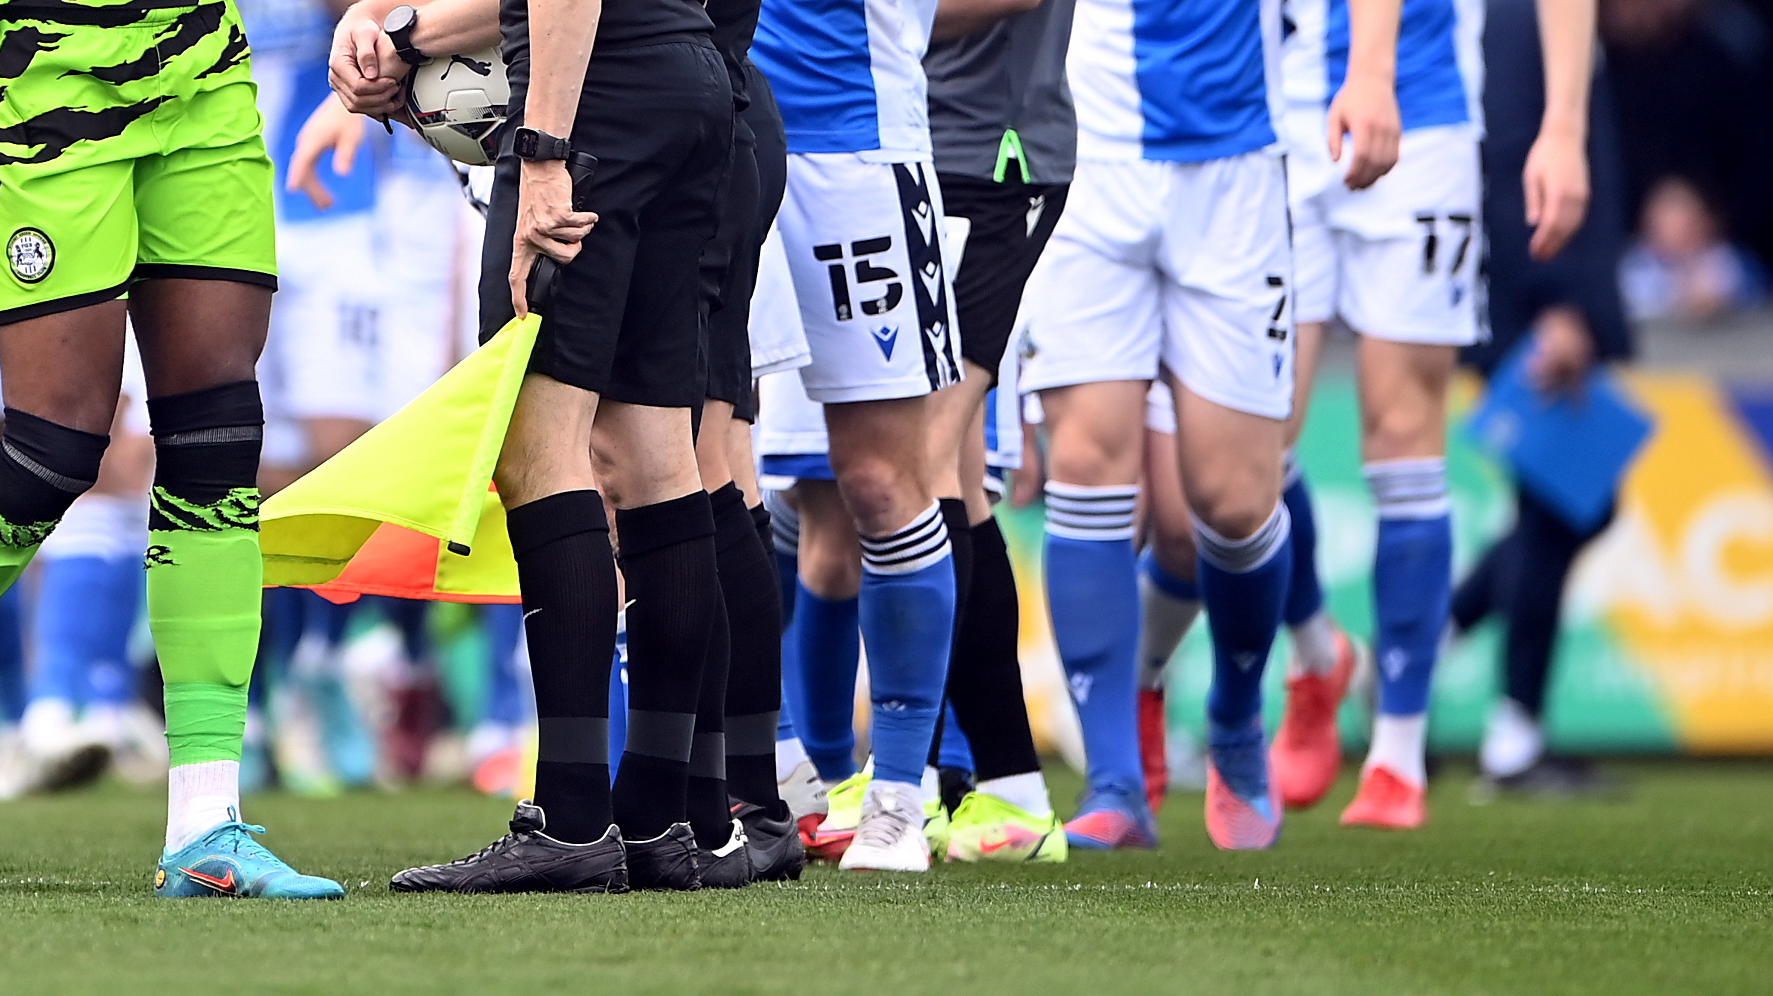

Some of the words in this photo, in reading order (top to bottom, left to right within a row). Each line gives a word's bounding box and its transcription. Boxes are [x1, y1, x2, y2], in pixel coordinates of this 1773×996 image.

[812, 235, 904, 321] 15
[1414, 213, 1473, 276] 17
[1265, 275, 1288, 343] 2
